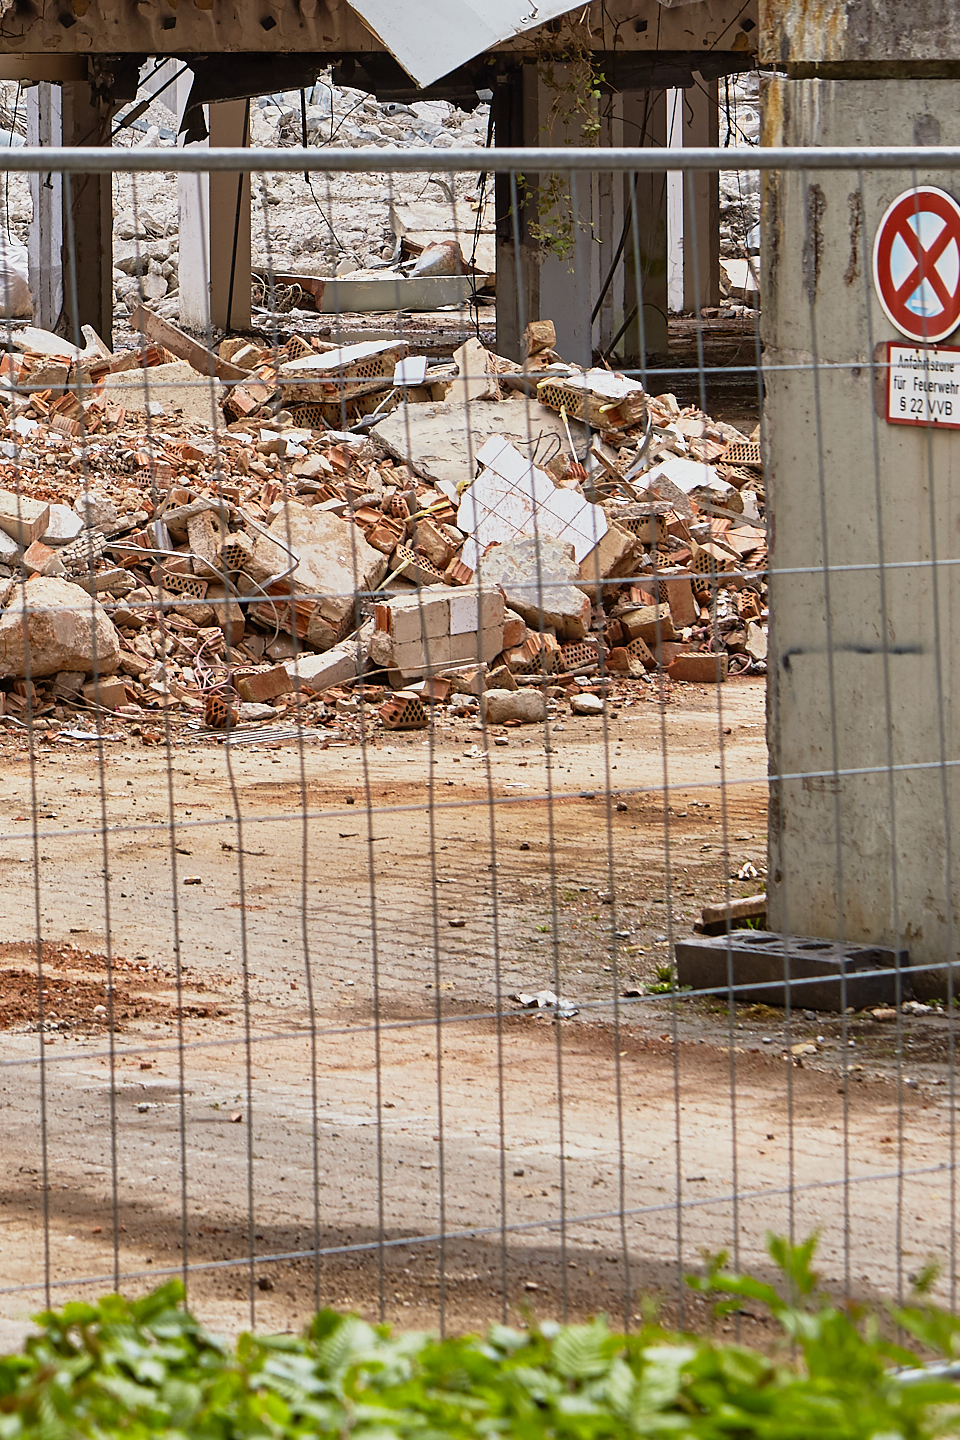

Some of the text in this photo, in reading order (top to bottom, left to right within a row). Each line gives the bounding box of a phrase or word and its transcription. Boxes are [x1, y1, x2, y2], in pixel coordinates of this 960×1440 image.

[897, 354, 955, 373] Anfahrtszone
[893, 374, 960, 395] für Feuerwehr
[900, 396, 953, 416] § 22 VVB
